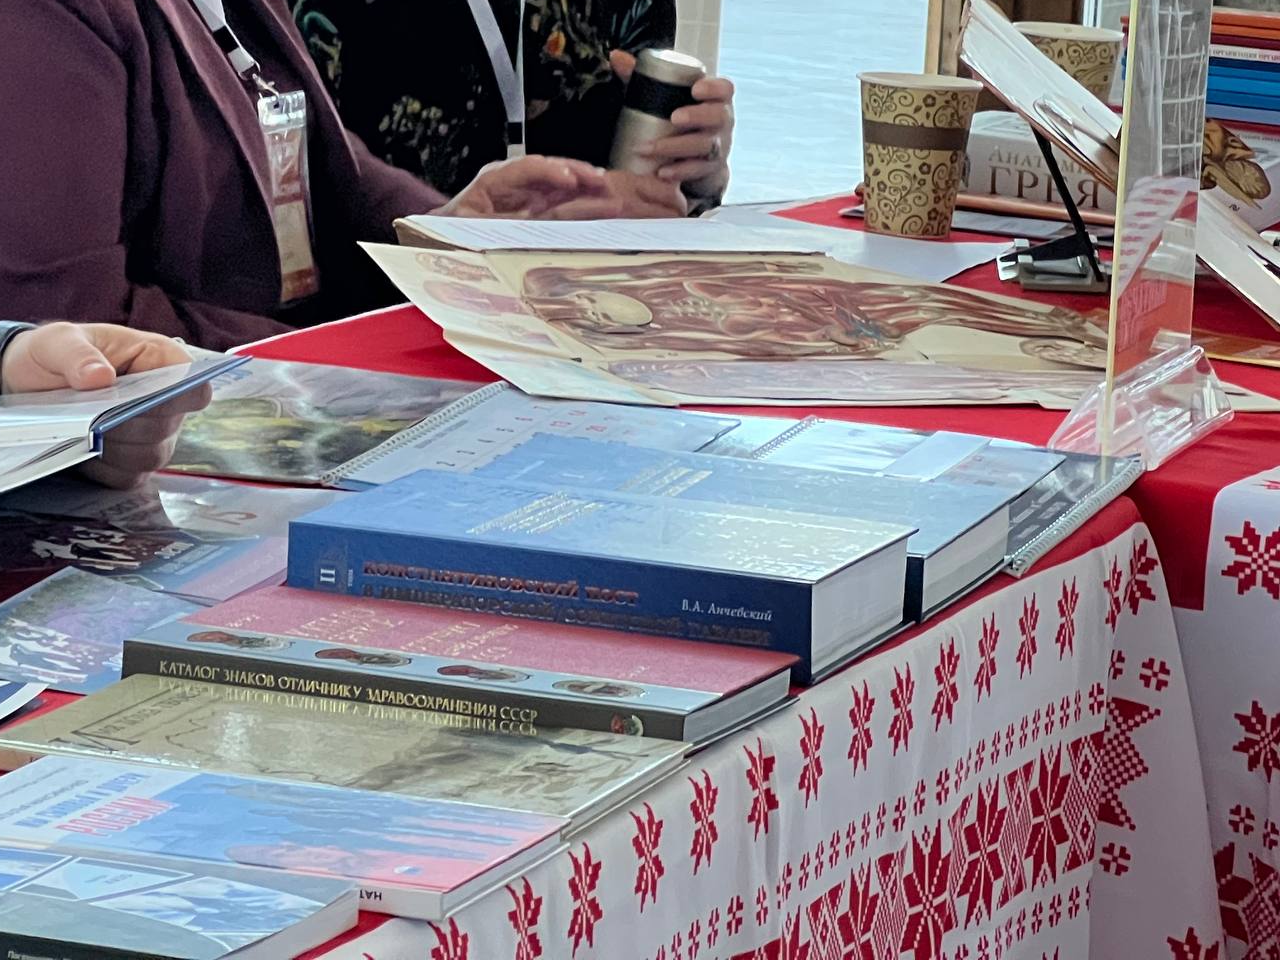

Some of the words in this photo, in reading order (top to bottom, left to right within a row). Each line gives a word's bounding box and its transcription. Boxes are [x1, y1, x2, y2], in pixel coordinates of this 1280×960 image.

[988, 146, 1088, 175] АНАТМ
[363, 561, 579, 599] КОНСТАНТИНОВСКИЙ
[585, 585, 639, 607] ПОСТ
[681, 599, 705, 616] В.А.
[708, 601, 773, 623] Анчевский
[159, 660, 220, 682] КАТАЛОГ
[223, 669, 276, 689] ЗНАКОВ
[278, 675, 363, 700] ОТЛИЧНИКУ
[366, 688, 497, 719] ЗДРАВООХРАНЕНИЯ
[499, 705, 539, 722] СССР
[52, 795, 176, 838] РОССИИ
